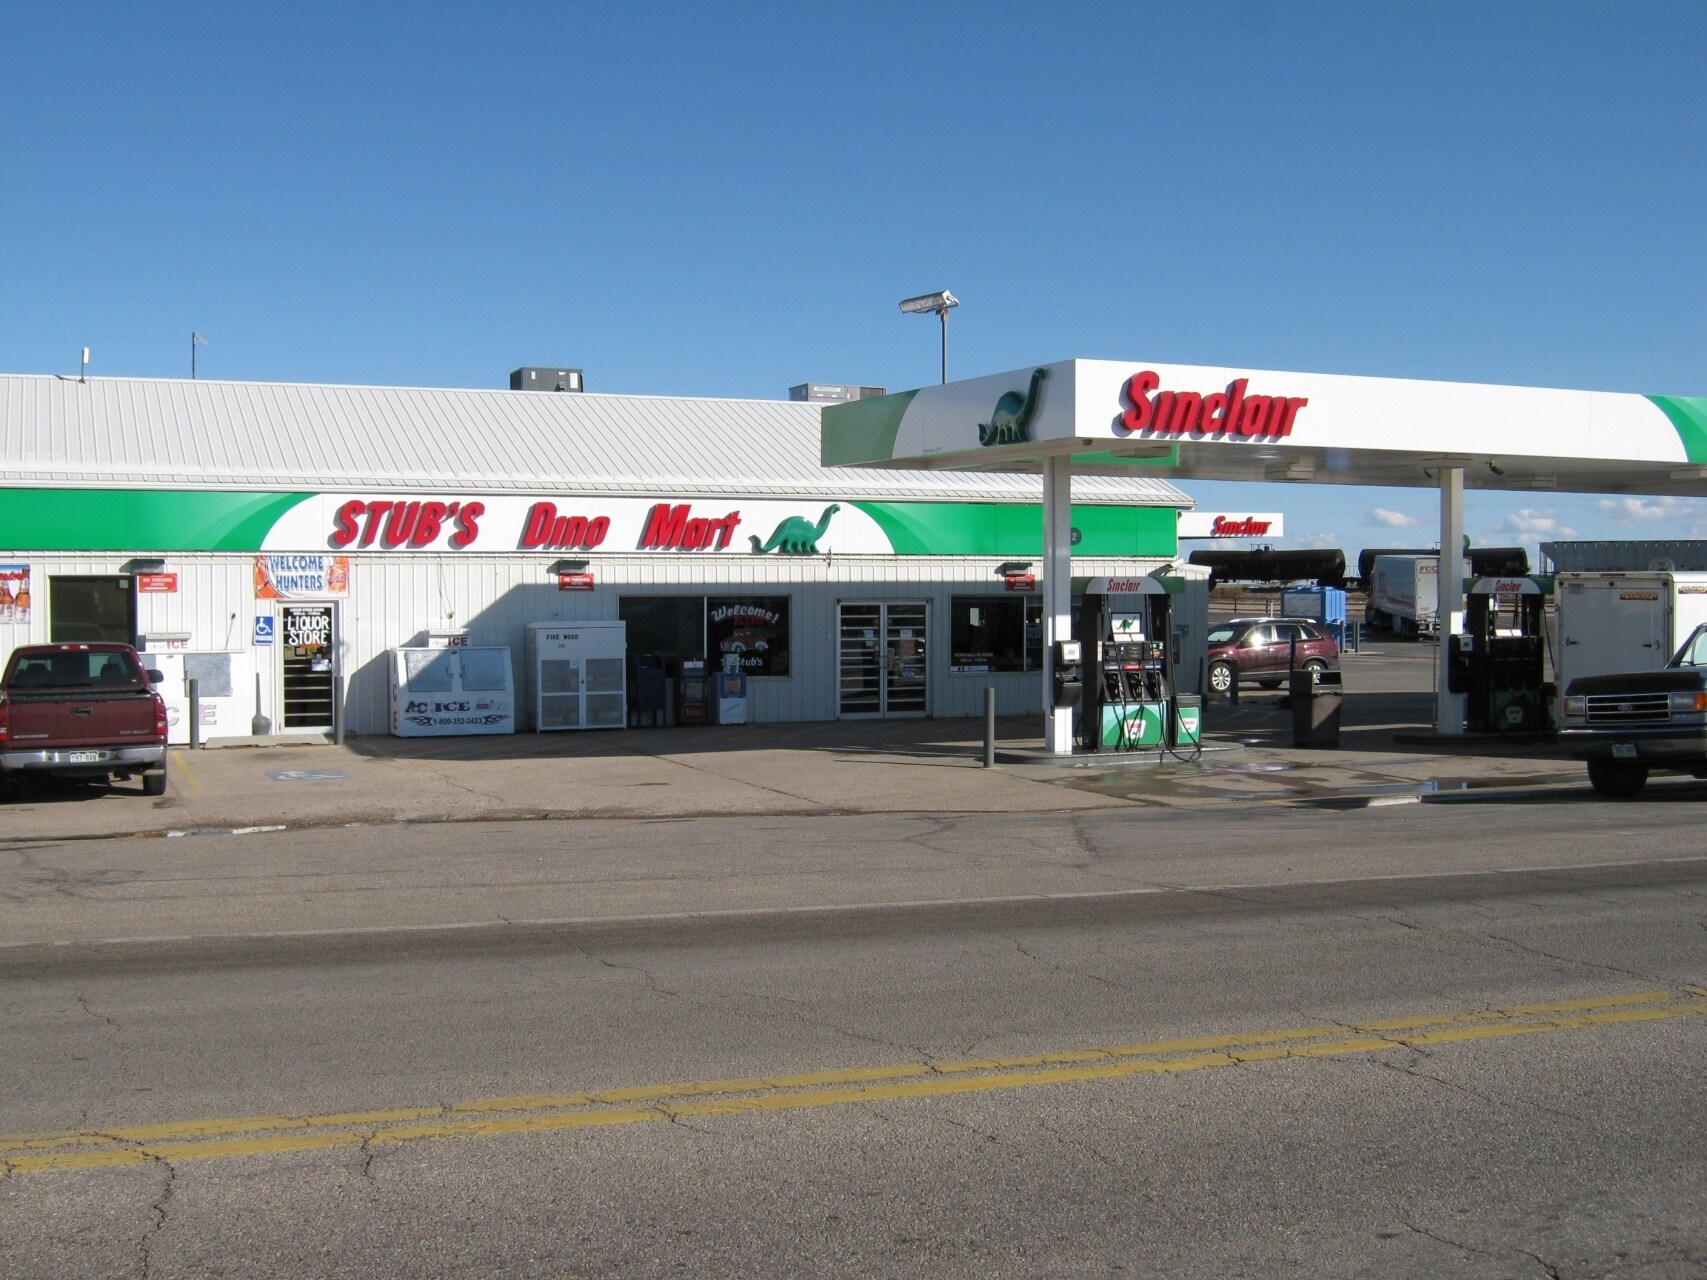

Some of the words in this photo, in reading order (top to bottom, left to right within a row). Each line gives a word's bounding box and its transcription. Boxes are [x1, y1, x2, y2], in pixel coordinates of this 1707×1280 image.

[1120, 370, 1309, 437] Sinclair
[333, 499, 486, 547] STUB'S
[521, 501, 611, 548] Dino
[640, 503, 741, 549] Mart
[1211, 515, 1273, 536] Sinclair
[1070, 532, 1077, 541] 2
[269, 555, 325, 571] WELCOME
[275, 574, 324, 591] HUNTERS
[1106, 578, 1141, 593] Sinclair
[1494, 579, 1522, 593] Sinclair
[710, 604, 780, 624] Welcome!
[287, 615, 330, 631] LIQUOR
[166, 640, 189, 650] ICE
[288, 629, 328, 646] STORE
[447, 636, 468, 647] ICE
[433, 700, 471, 713] ICE
